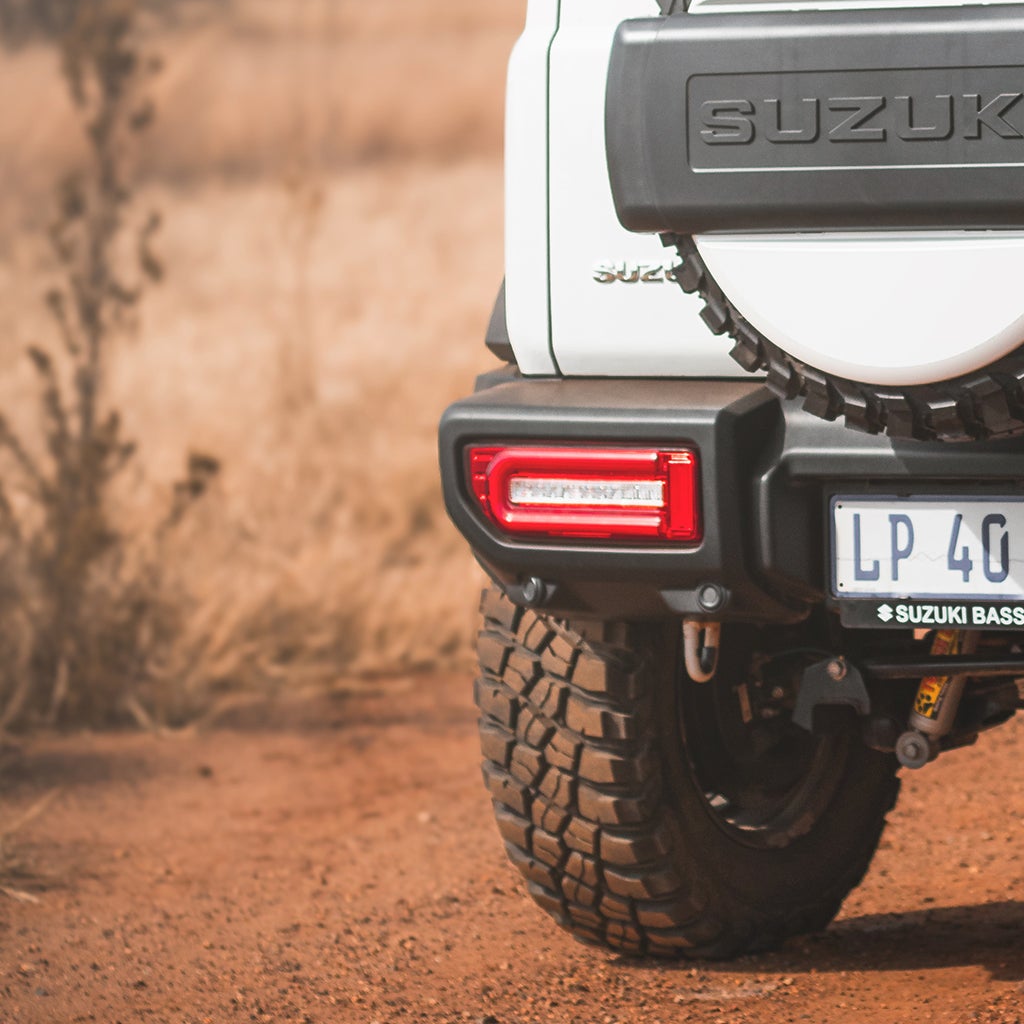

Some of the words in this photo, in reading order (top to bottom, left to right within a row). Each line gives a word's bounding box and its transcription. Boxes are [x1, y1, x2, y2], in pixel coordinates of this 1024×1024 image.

[592, 261, 678, 283] SUZU
[853, 513, 914, 581] LP
[947, 513, 1009, 583] 40
[895, 605, 967, 624] SUZUKI
